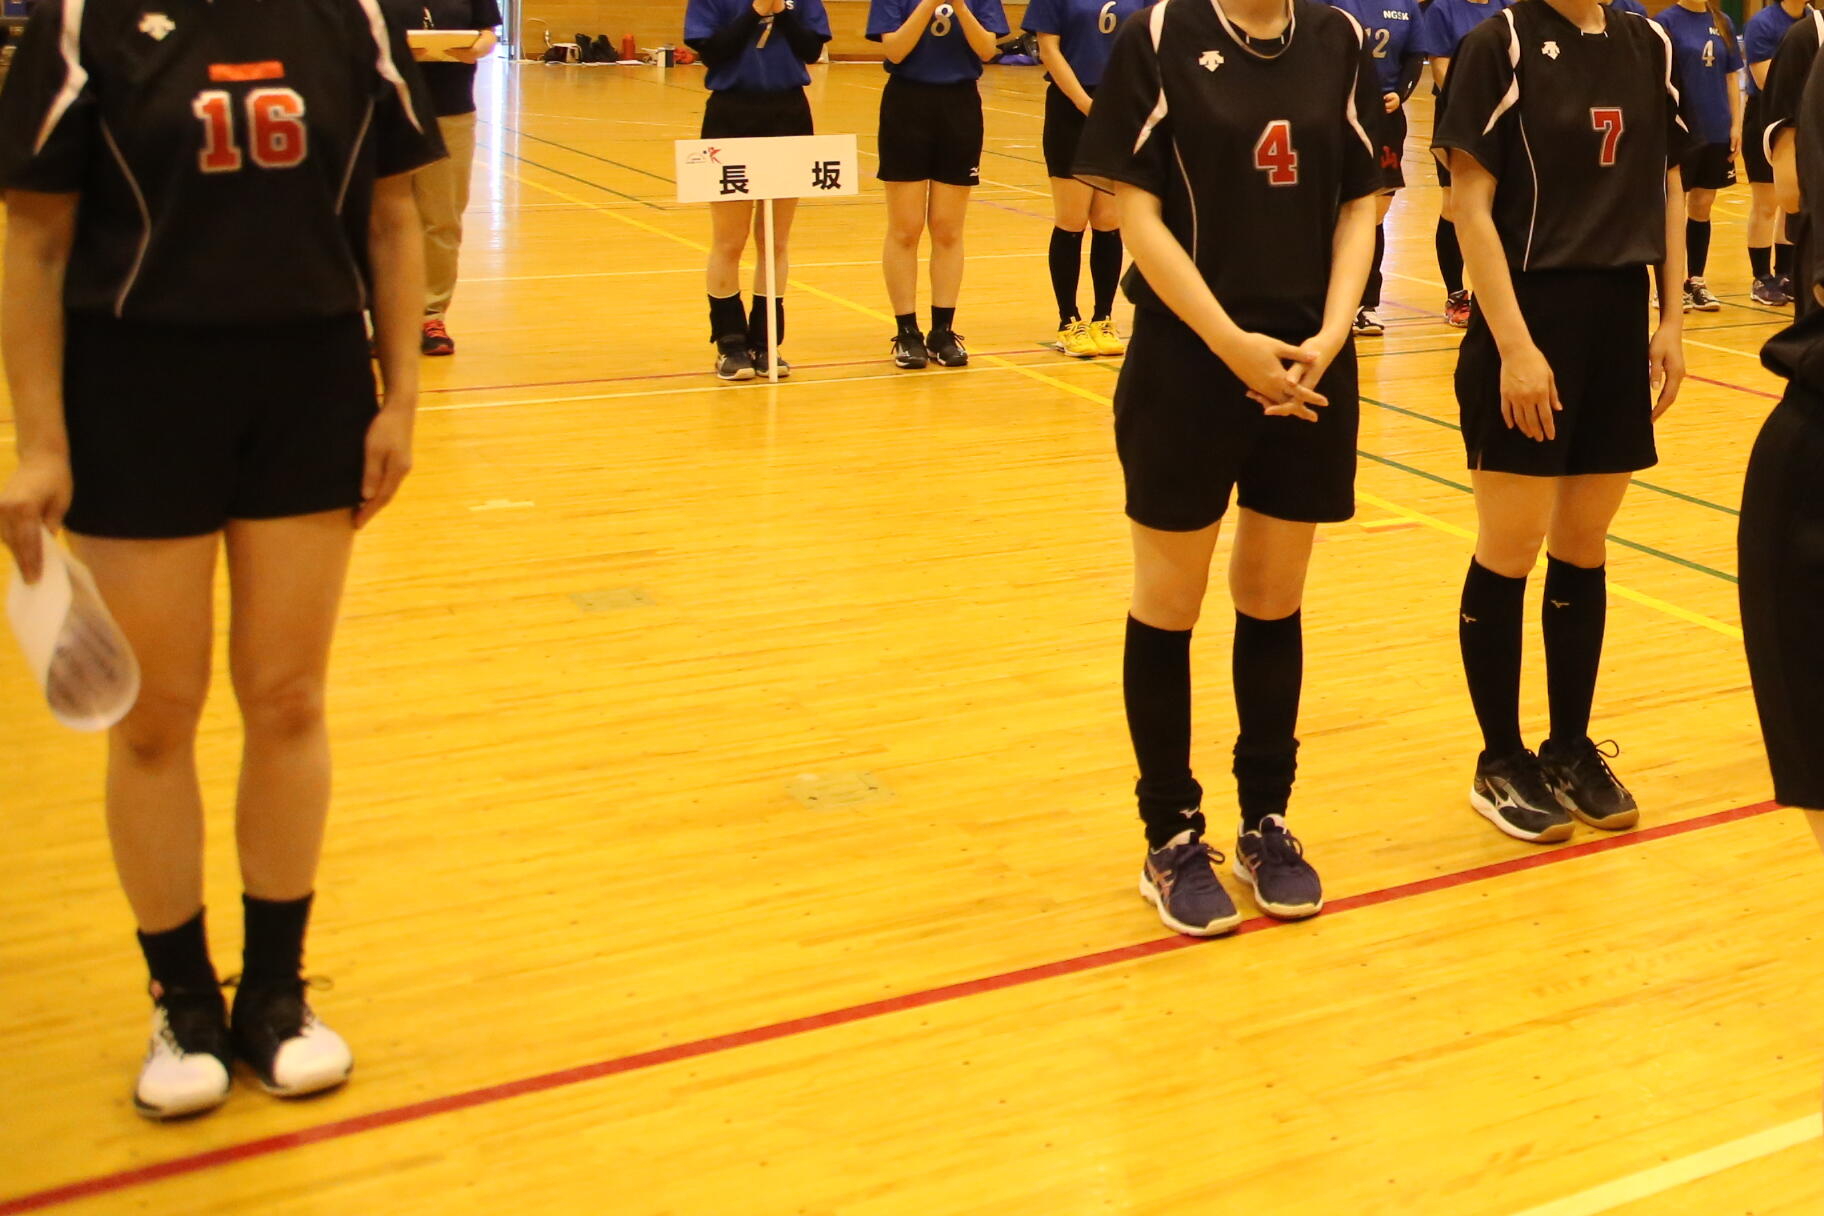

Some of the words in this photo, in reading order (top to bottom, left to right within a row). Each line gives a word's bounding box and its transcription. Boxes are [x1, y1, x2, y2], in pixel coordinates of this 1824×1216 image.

[756, 15, 775, 49] 7
[931, 3, 954, 37] 8
[1098, 0, 1117, 34] 6
[1383, 10, 1409, 21] NGSK
[1364, 27, 1390, 59] 2
[1702, 39, 1716, 68] 4
[192, 87, 308, 174] 16
[1589, 106, 1623, 167] 7
[1255, 119, 1298, 186] 4
